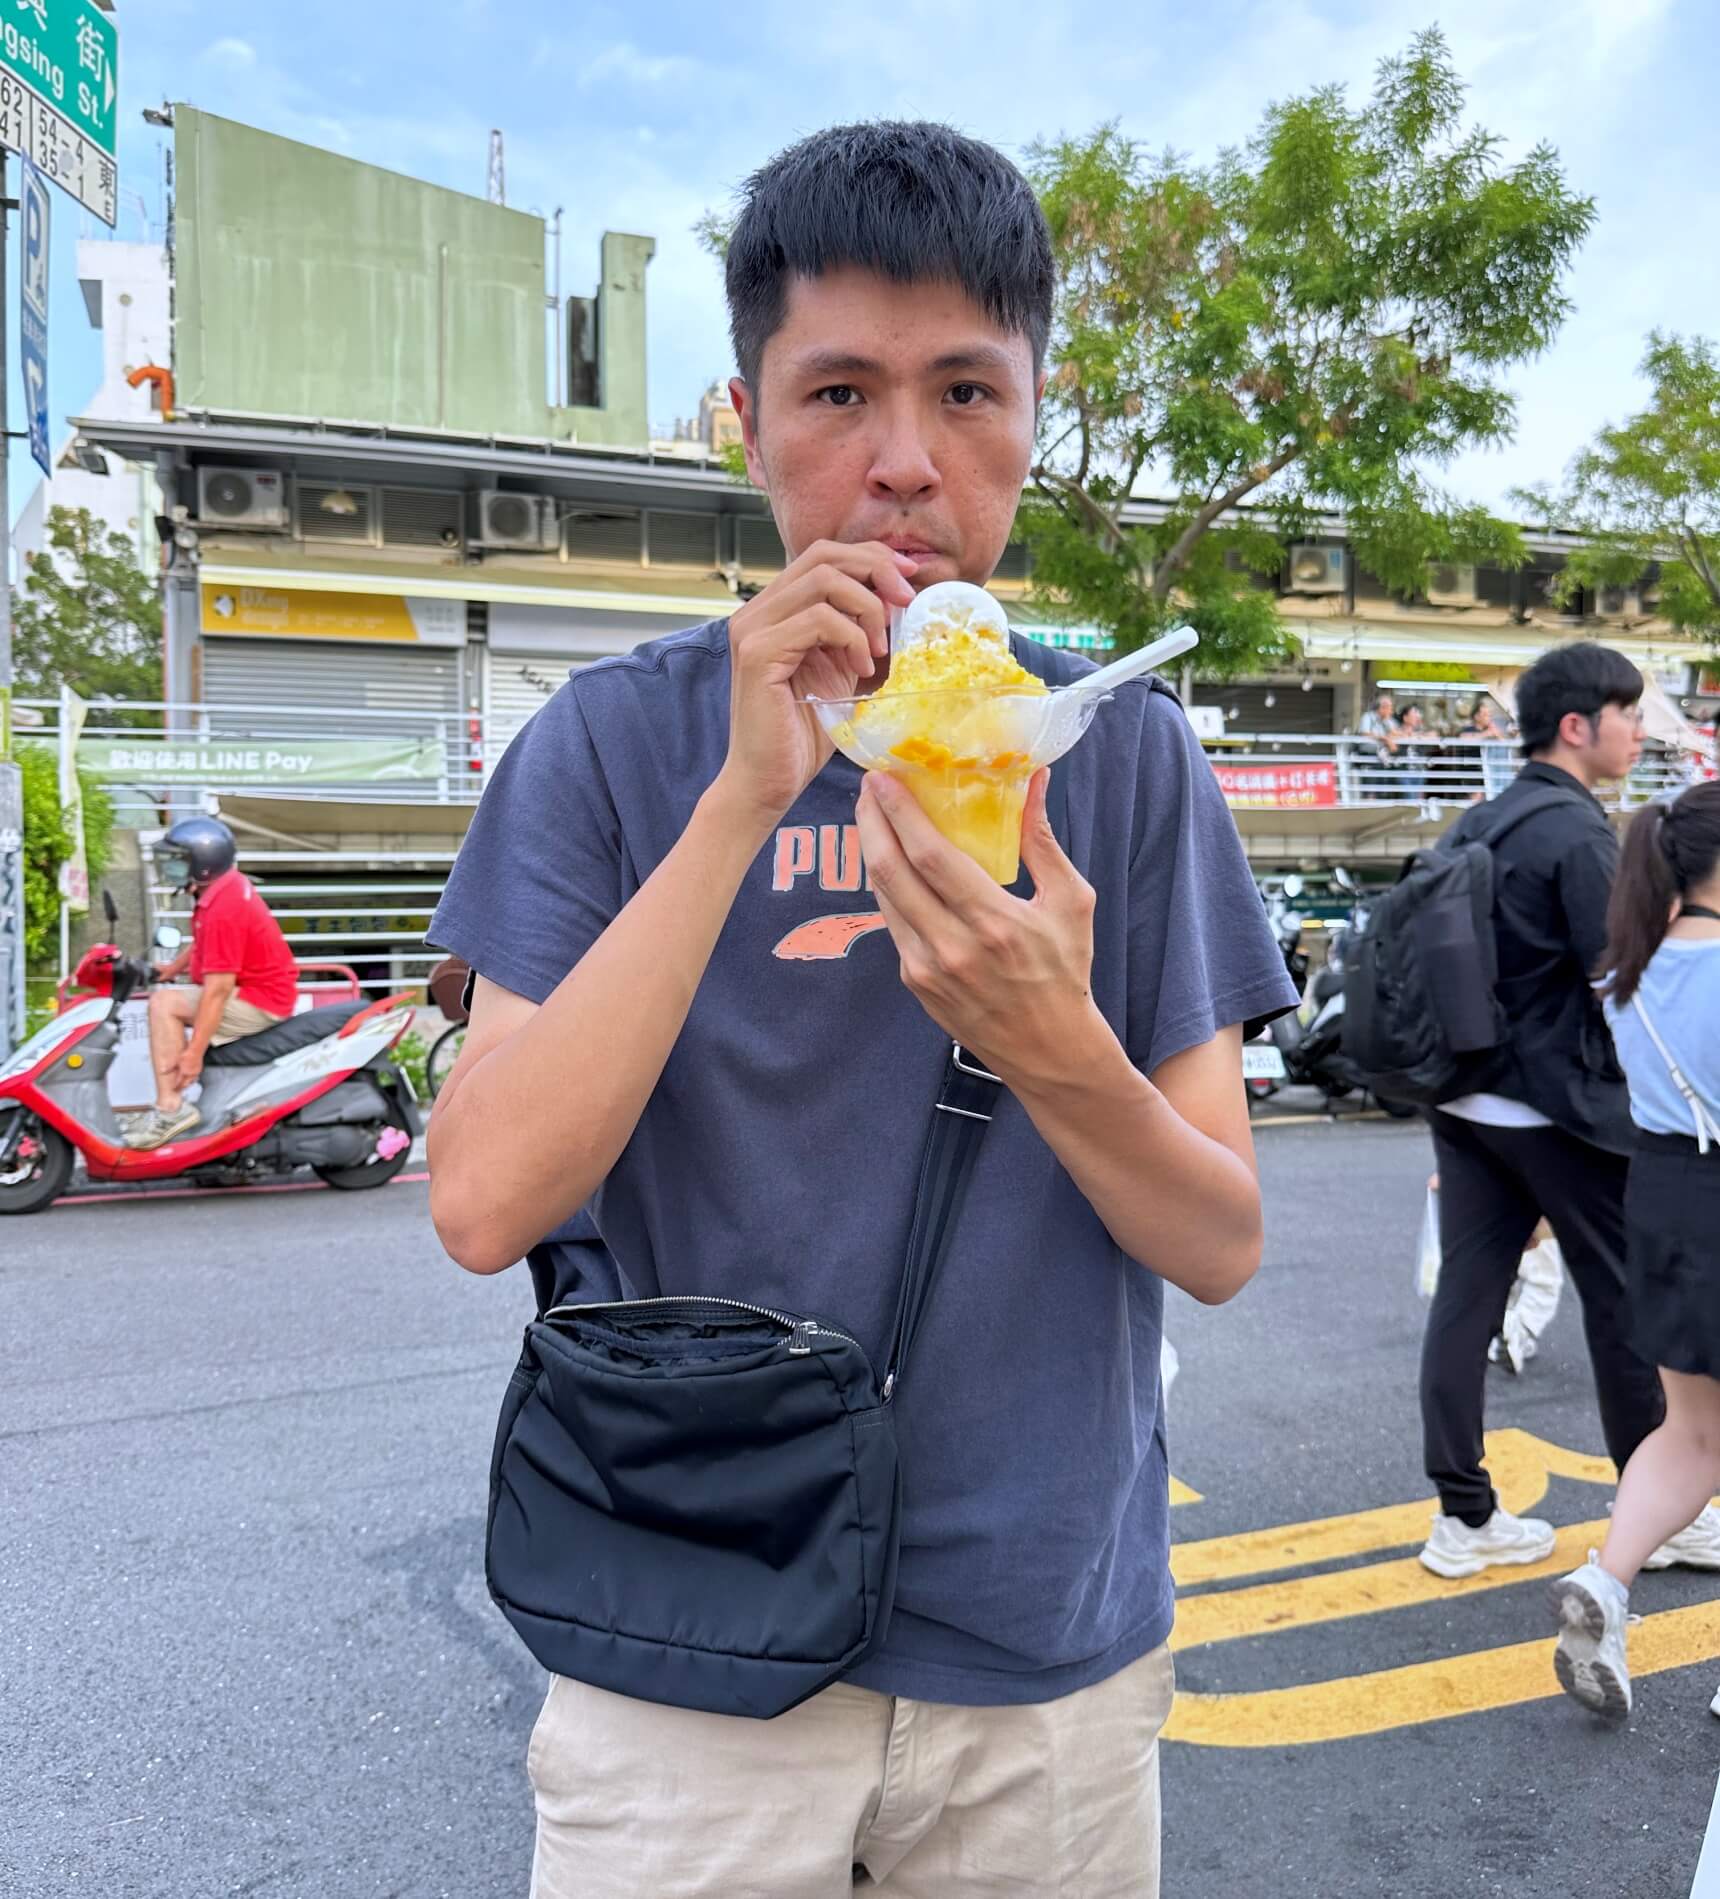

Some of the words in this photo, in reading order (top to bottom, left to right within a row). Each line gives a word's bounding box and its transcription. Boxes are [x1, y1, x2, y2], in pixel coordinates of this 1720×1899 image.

[0, 15, 64, 101] gsing
[77, 80, 104, 129] St.
[201, 750, 260, 770] LINE
[265, 751, 314, 773] Pay
[772, 824, 876, 893] PU
